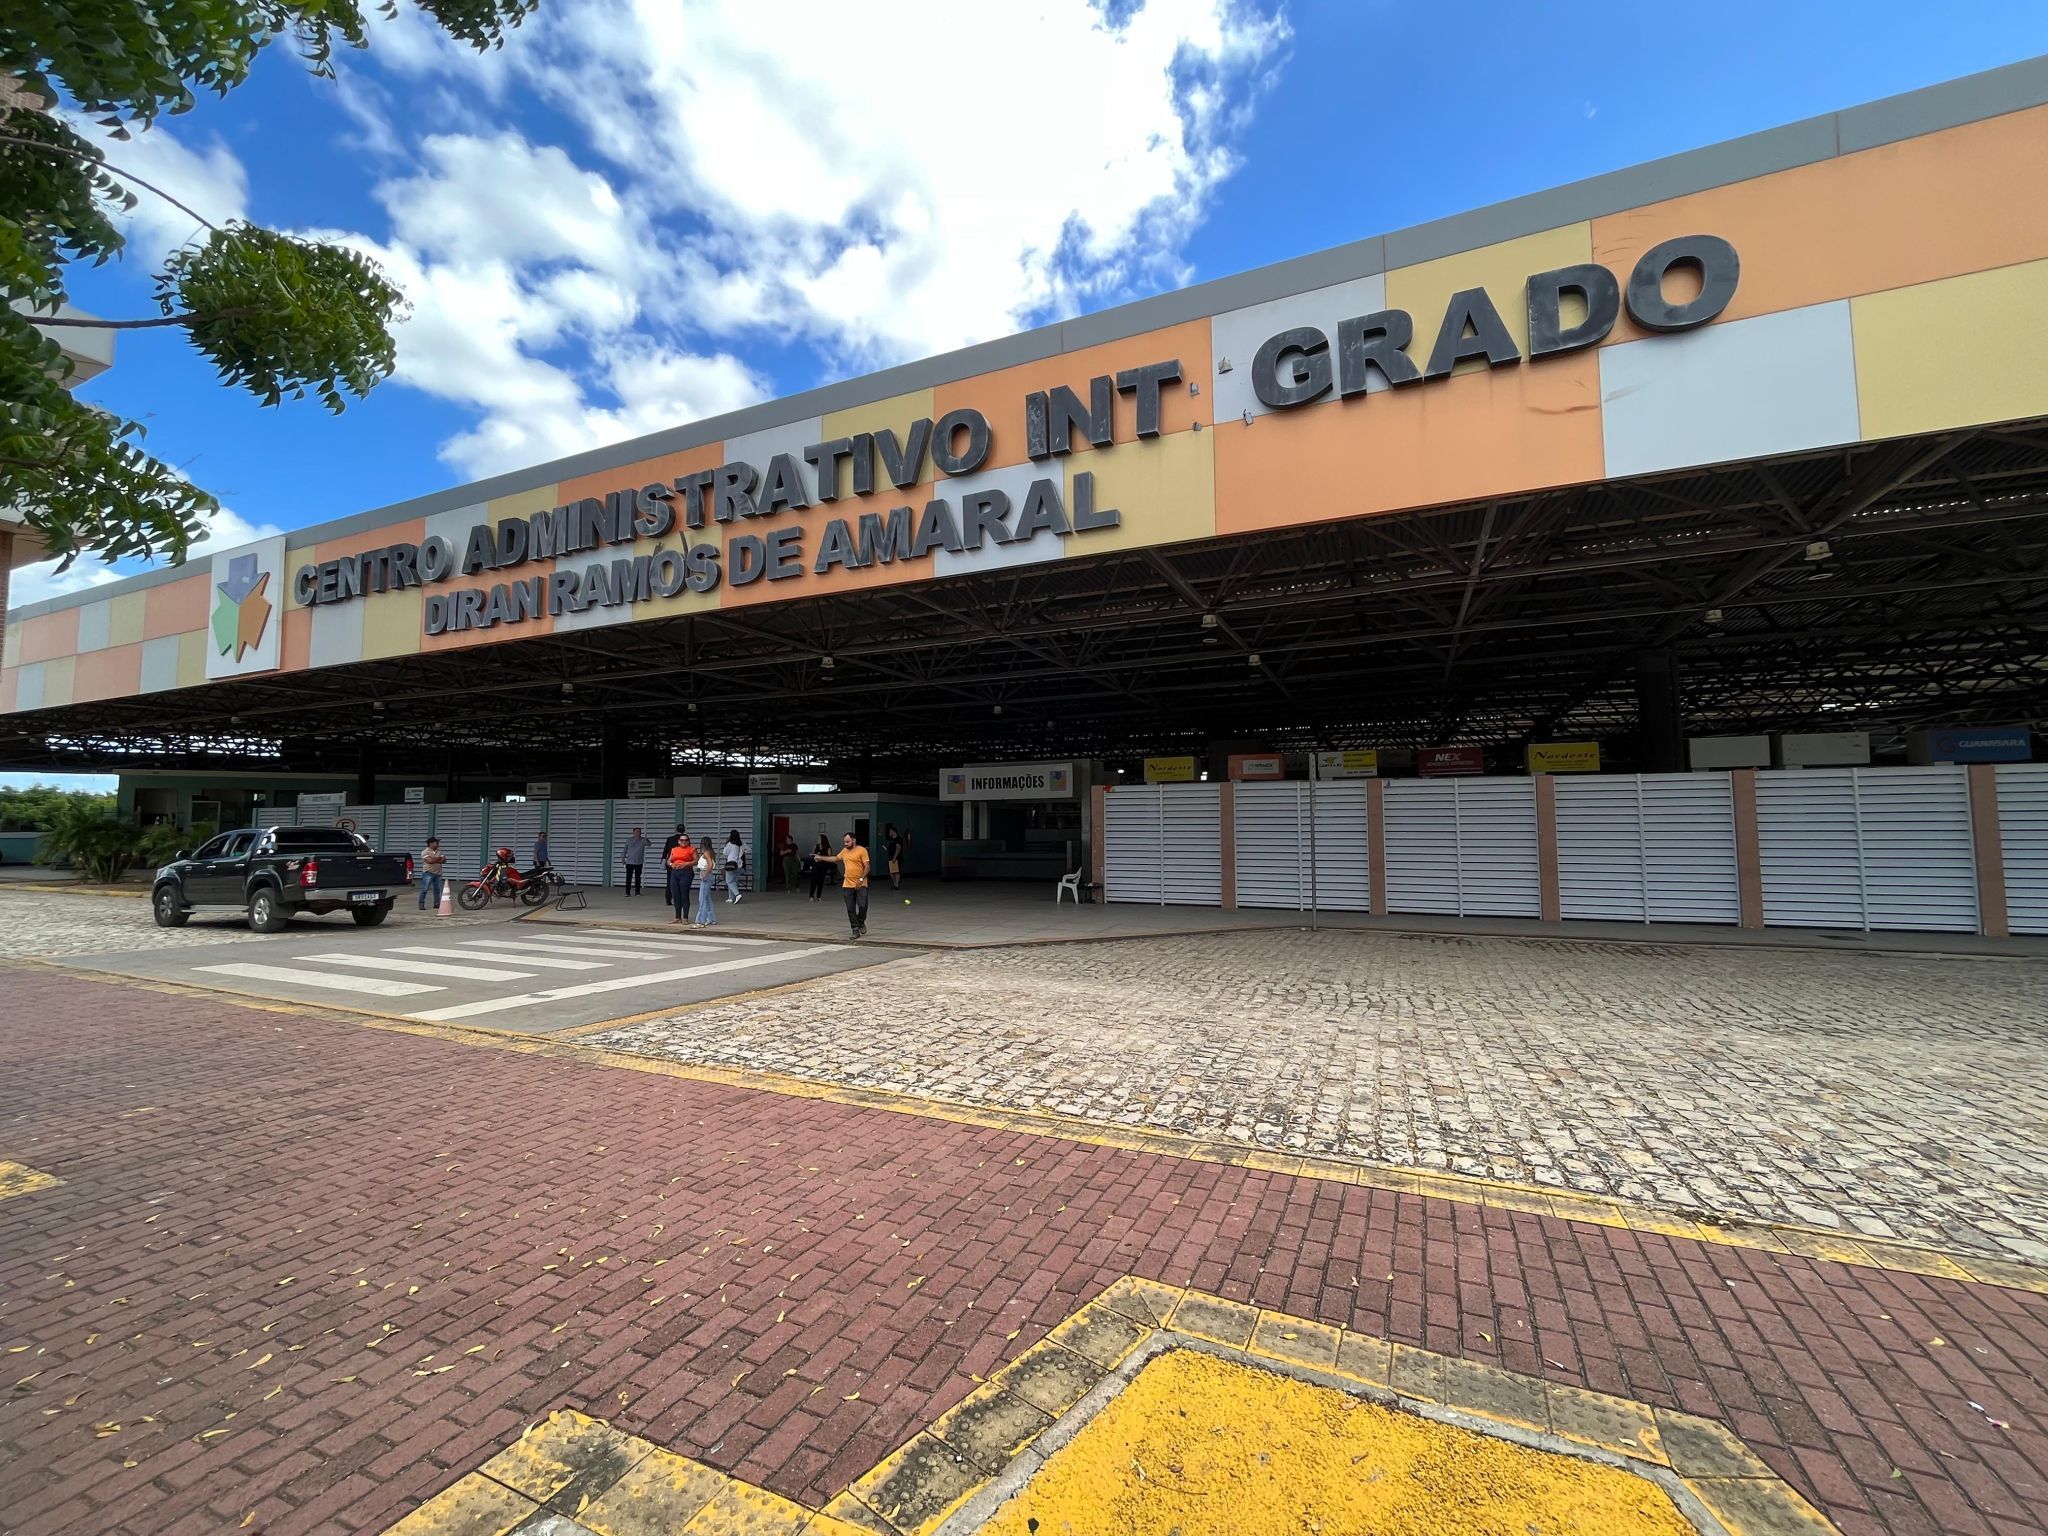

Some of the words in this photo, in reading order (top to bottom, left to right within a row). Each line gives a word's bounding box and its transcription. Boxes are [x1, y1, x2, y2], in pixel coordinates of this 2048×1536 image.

[294, 535, 454, 607] CENTRO
[462, 408, 993, 575] ADMINISTRATIVO
[1025, 358, 1184, 462] INT
[1251, 234, 1741, 410] GRADO
[424, 576, 545, 636] DIRAN
[548, 543, 721, 615] RAMOS
[728, 525, 804, 587] DE
[813, 471, 1121, 574] AMARAL
[1434, 753, 1463, 762] NEX
[1533, 751, 1597, 760] Nordeste
[971, 774, 1045, 791] INFORMAÇÕES
